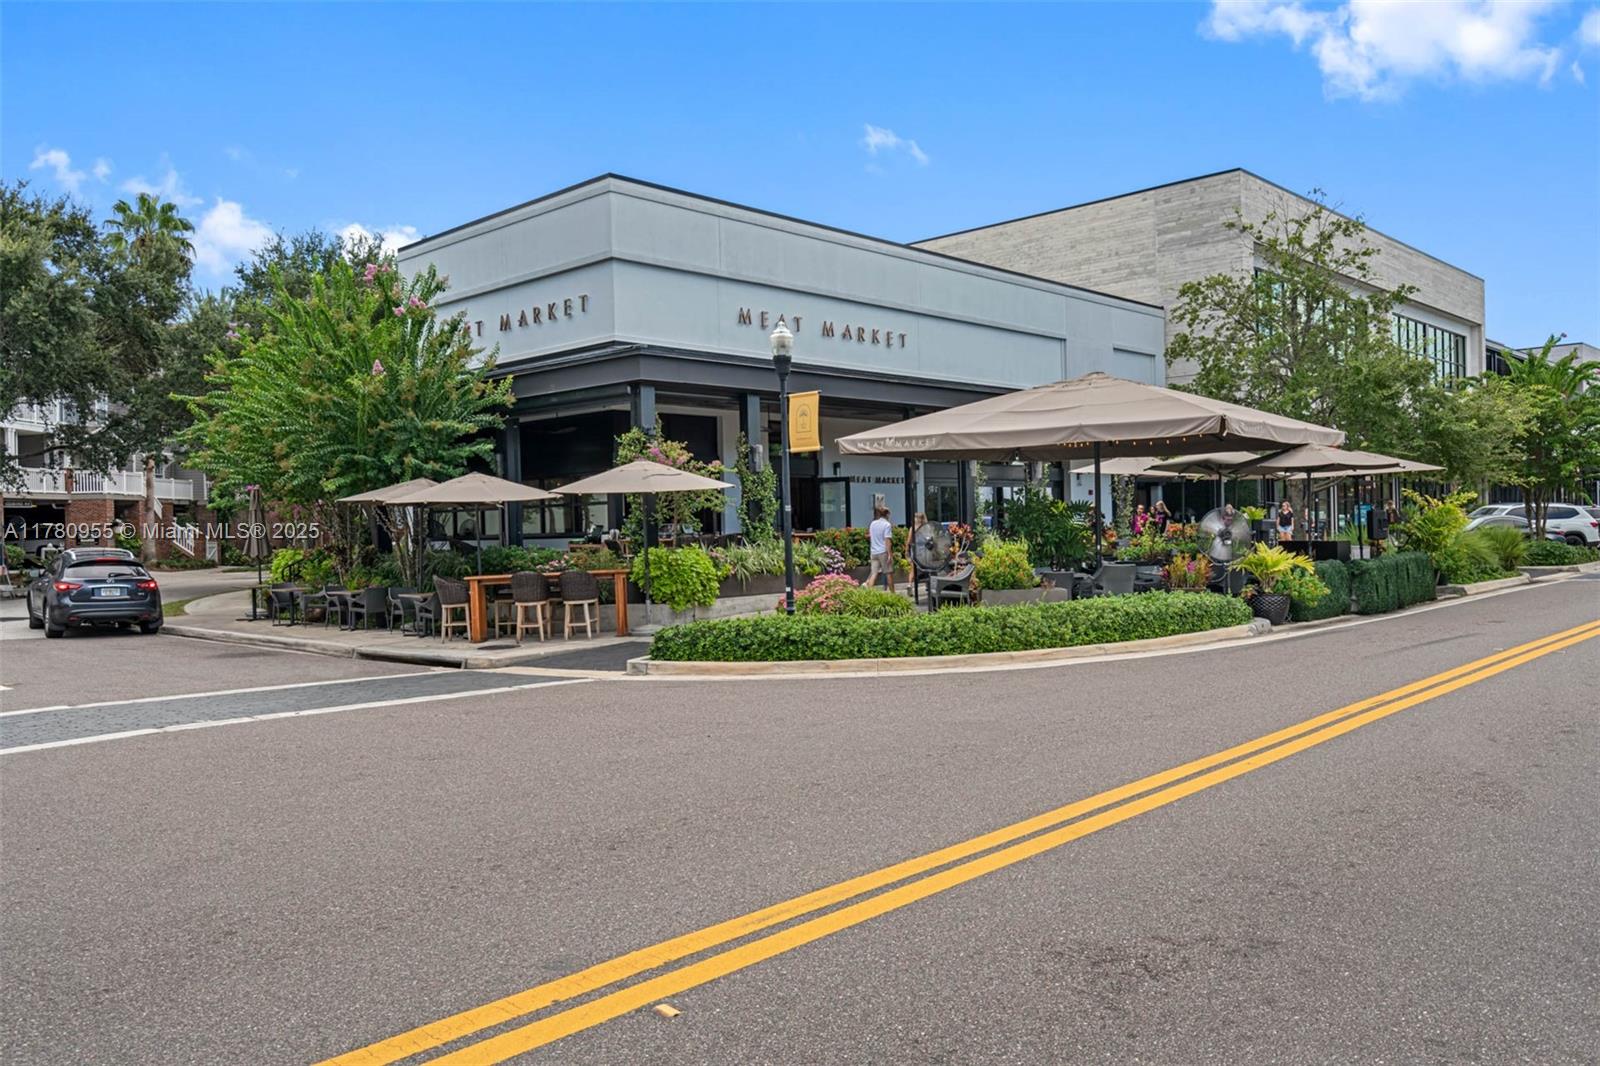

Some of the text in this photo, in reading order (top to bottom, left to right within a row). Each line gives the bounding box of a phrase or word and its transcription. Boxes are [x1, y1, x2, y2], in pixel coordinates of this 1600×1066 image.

[499, 294, 589, 331] MARKET
[738, 307, 907, 348] MEAT MARKET
[875, 476, 904, 484] MARKET
